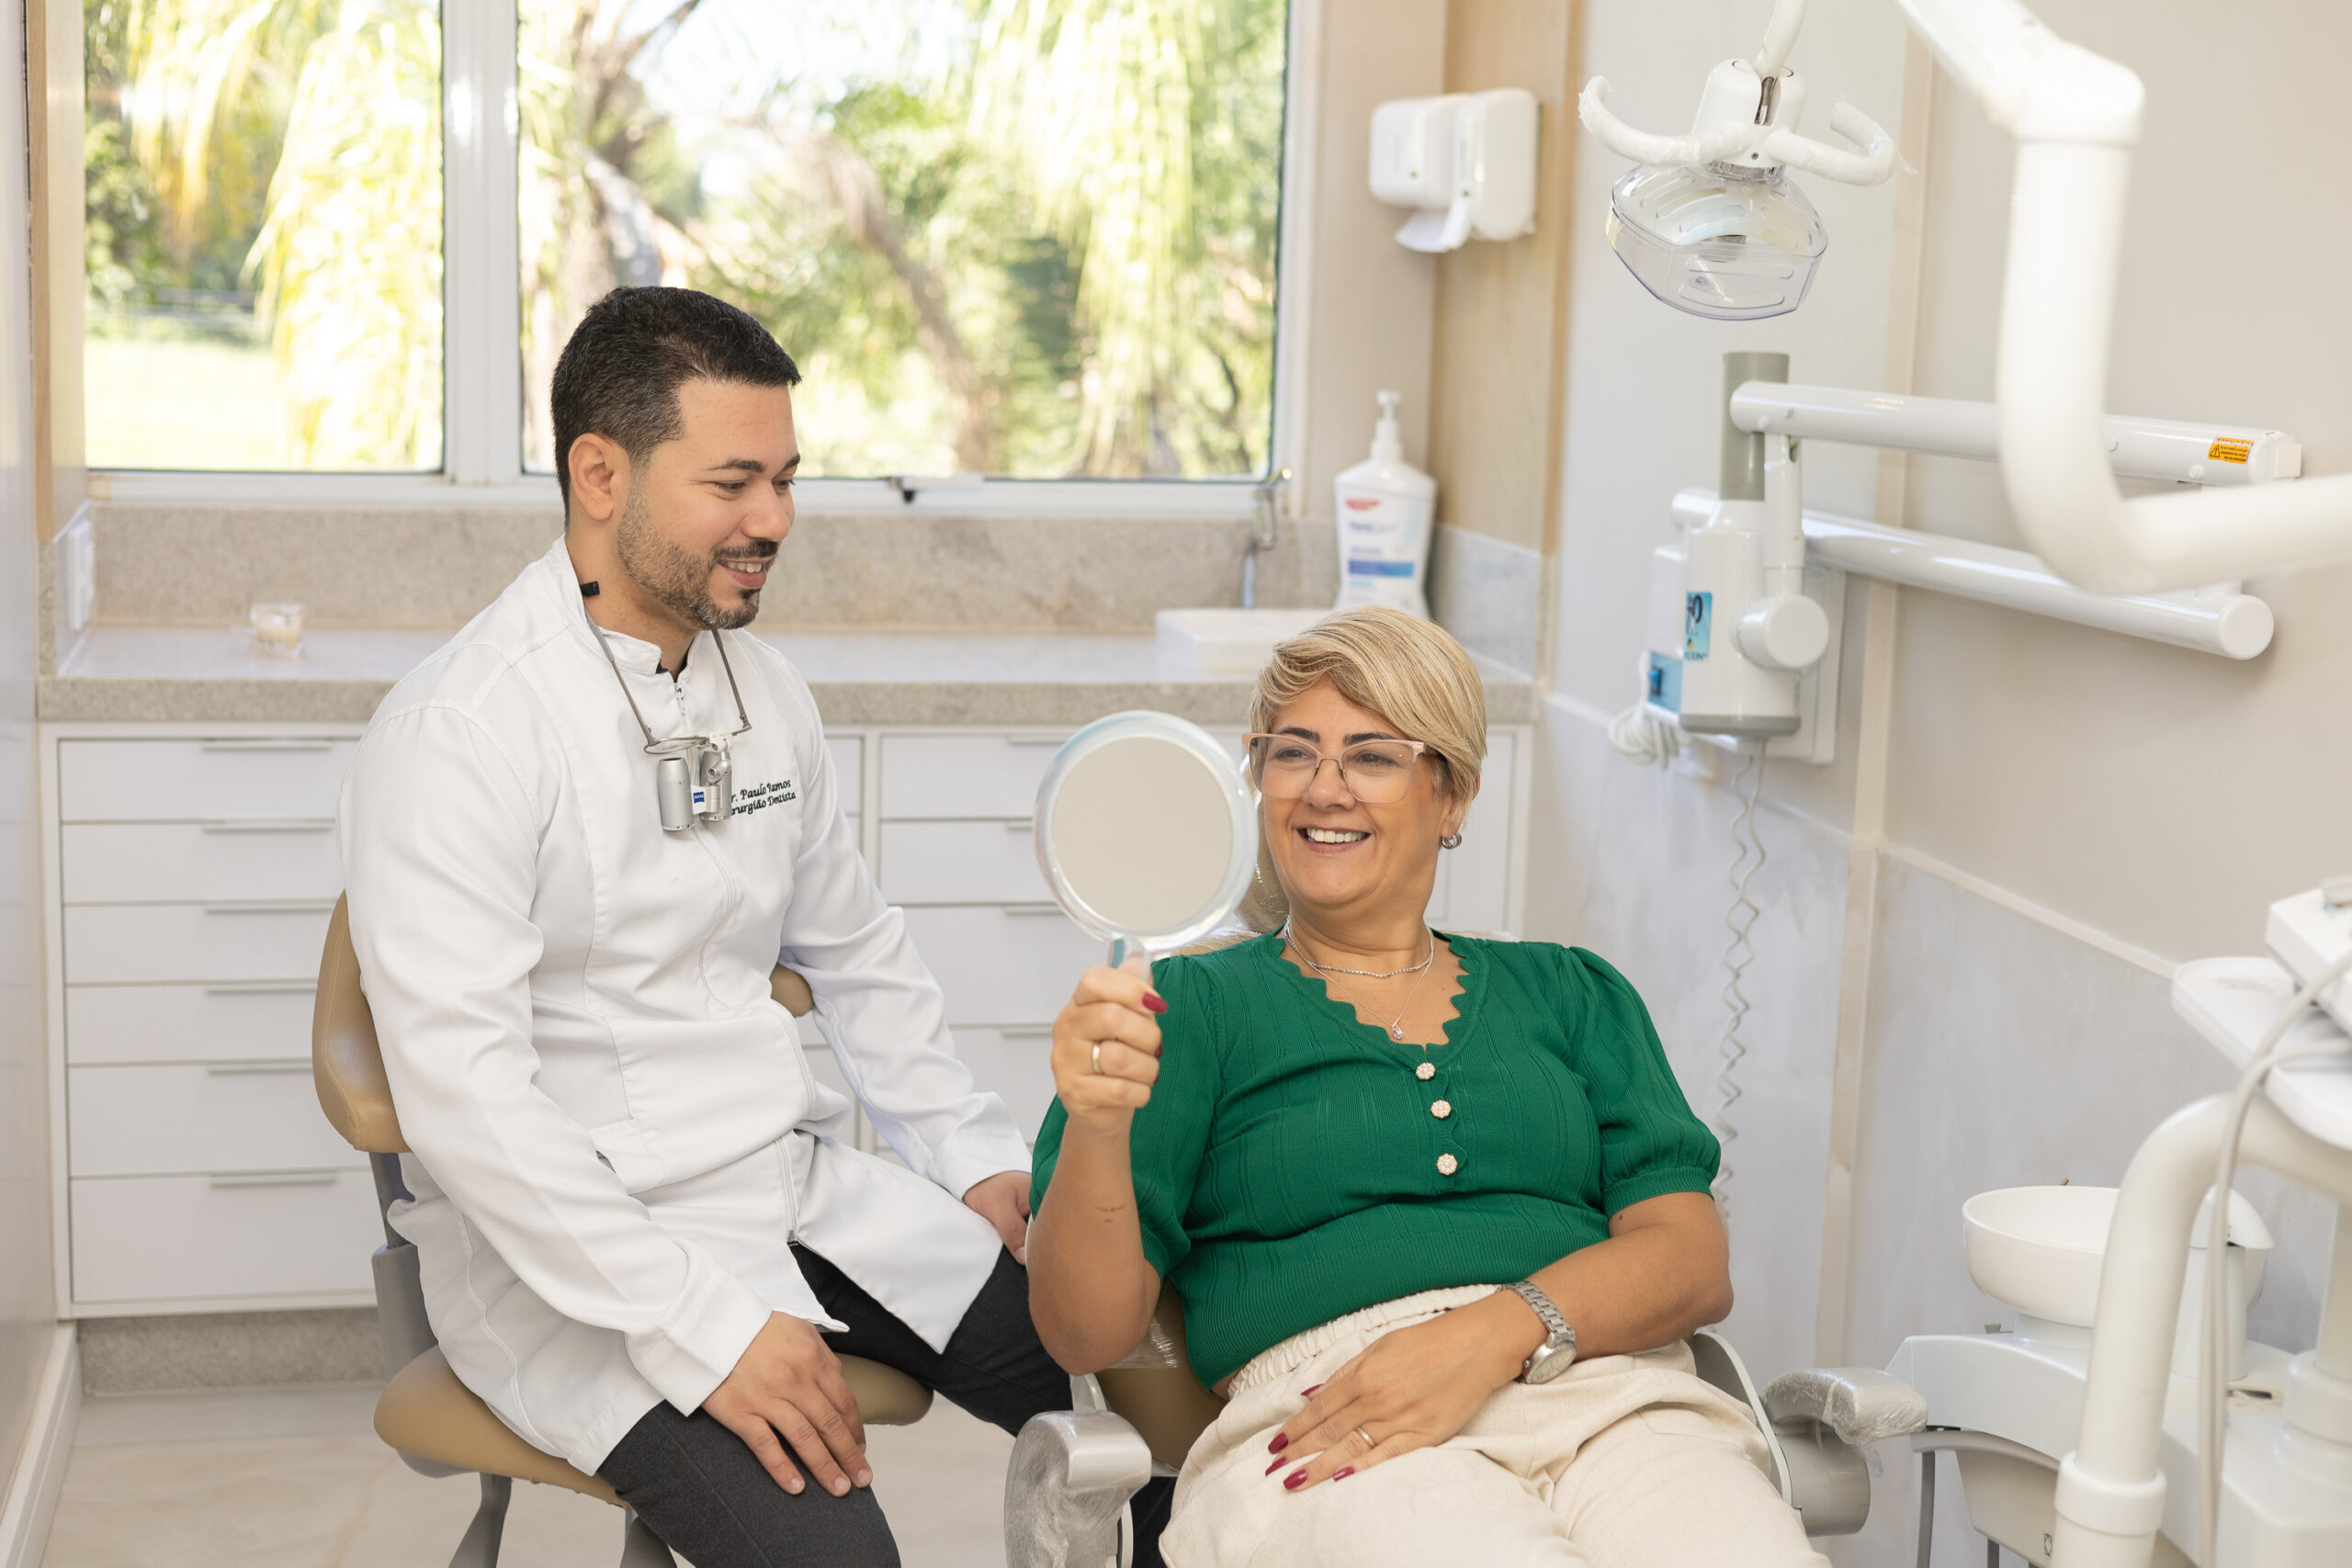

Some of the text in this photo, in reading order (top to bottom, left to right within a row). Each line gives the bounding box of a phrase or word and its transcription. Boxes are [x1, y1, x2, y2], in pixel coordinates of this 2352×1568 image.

[740, 783, 767, 800] Paulo
[731, 792, 796, 816] rurgião Dentista
